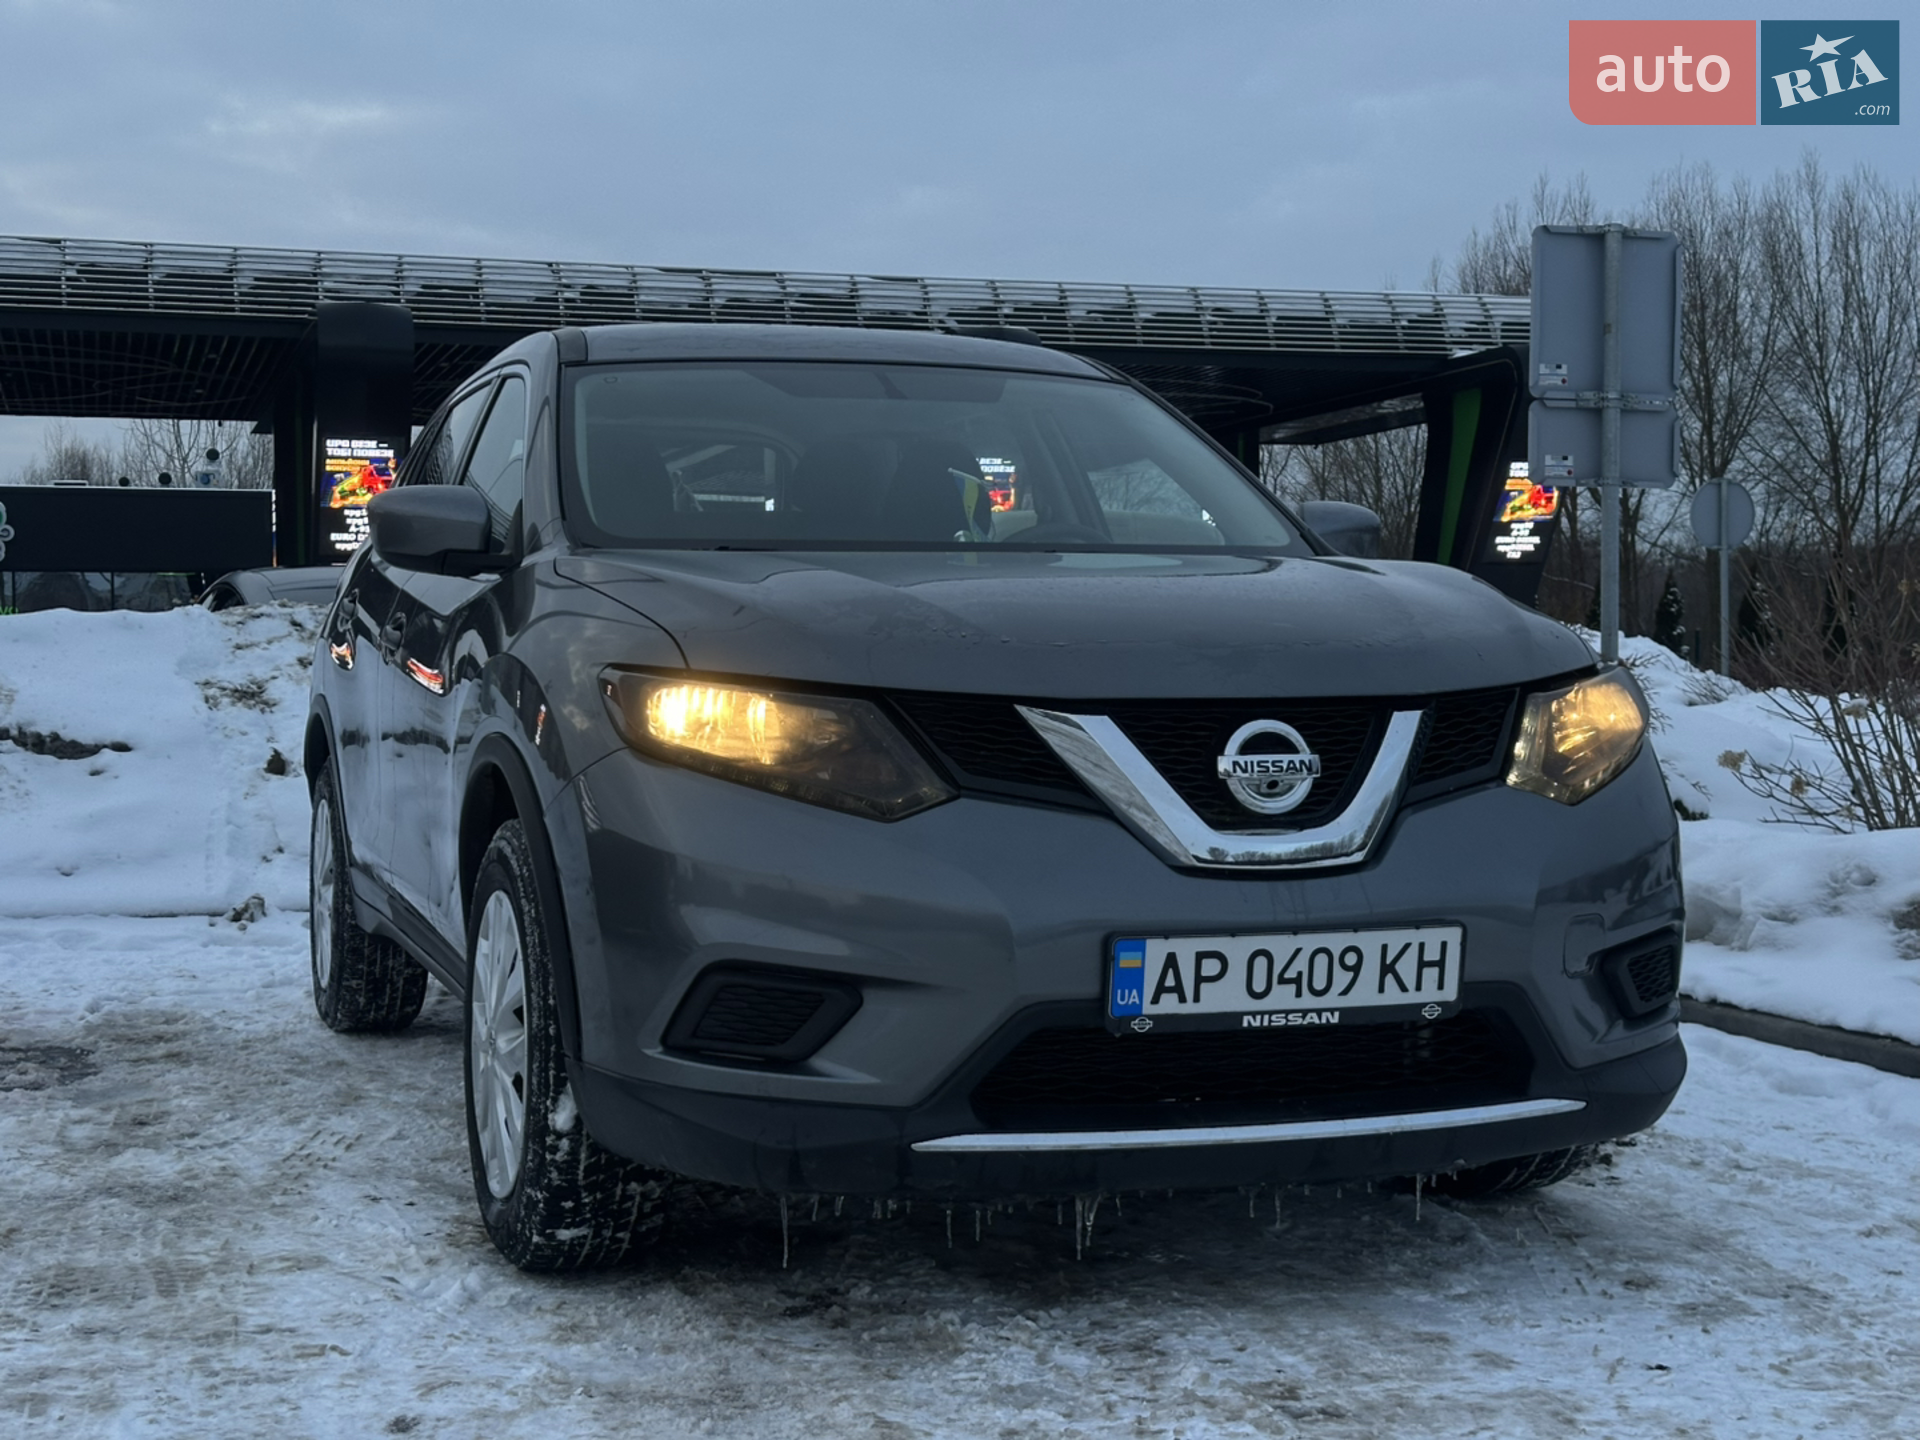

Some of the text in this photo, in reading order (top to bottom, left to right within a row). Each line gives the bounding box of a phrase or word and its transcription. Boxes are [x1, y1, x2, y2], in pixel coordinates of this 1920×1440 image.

[1231, 759, 1313, 774] NISSAN
[1116, 940, 1448, 1006] UA AP 0409 KH
[1241, 1010, 1340, 1028] NISSAN
